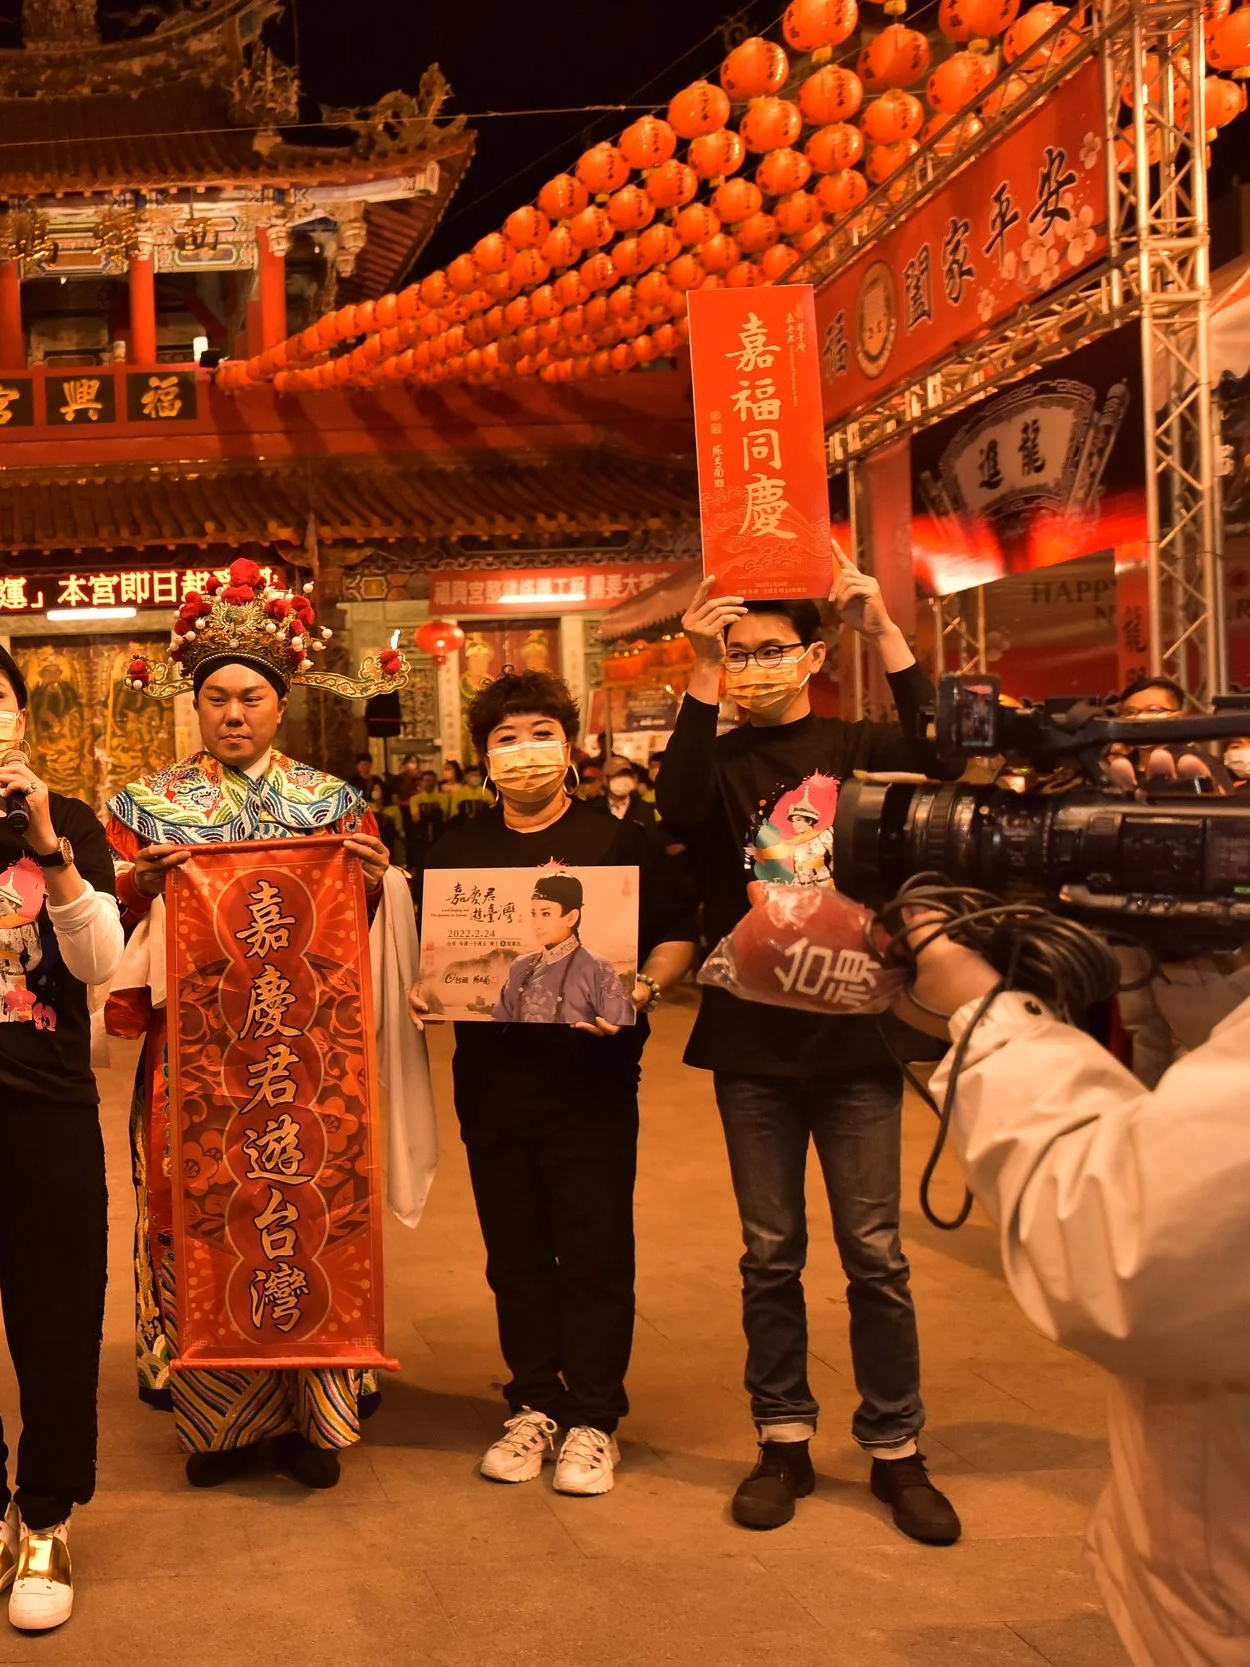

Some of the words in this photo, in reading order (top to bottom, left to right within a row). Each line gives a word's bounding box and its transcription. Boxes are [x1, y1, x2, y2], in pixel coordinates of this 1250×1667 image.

[725, 312, 798, 540] 嘉福同慶
[446, 882, 496, 906] 嘉慶君
[447, 929, 496, 938] 2022.2.24
[235, 879, 314, 1335] 嘉慶君遊台灣
